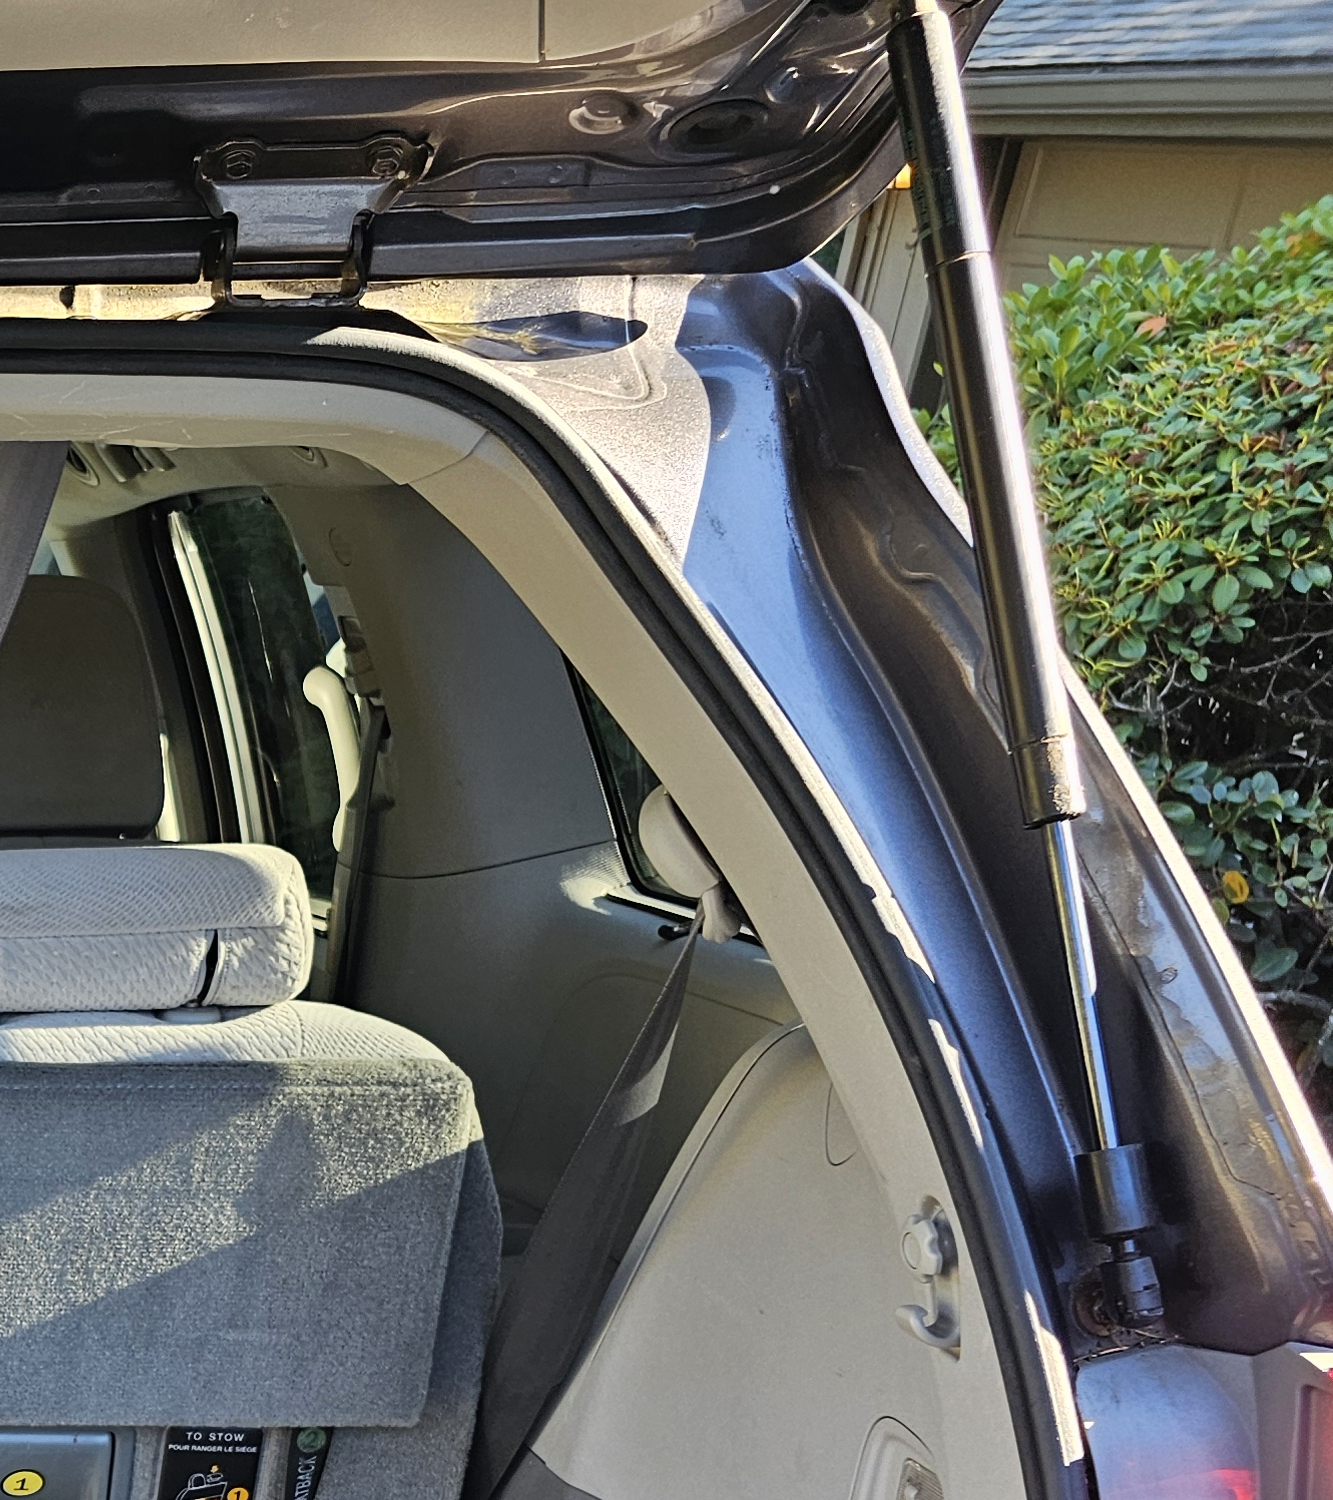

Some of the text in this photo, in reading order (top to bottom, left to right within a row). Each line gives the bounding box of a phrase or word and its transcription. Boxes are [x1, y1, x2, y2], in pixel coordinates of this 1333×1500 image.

[186, 1432, 245, 1442] TO STOW
[190, 1444, 223, 1452] RANGER
[14, 1478, 29, 1491] 1
